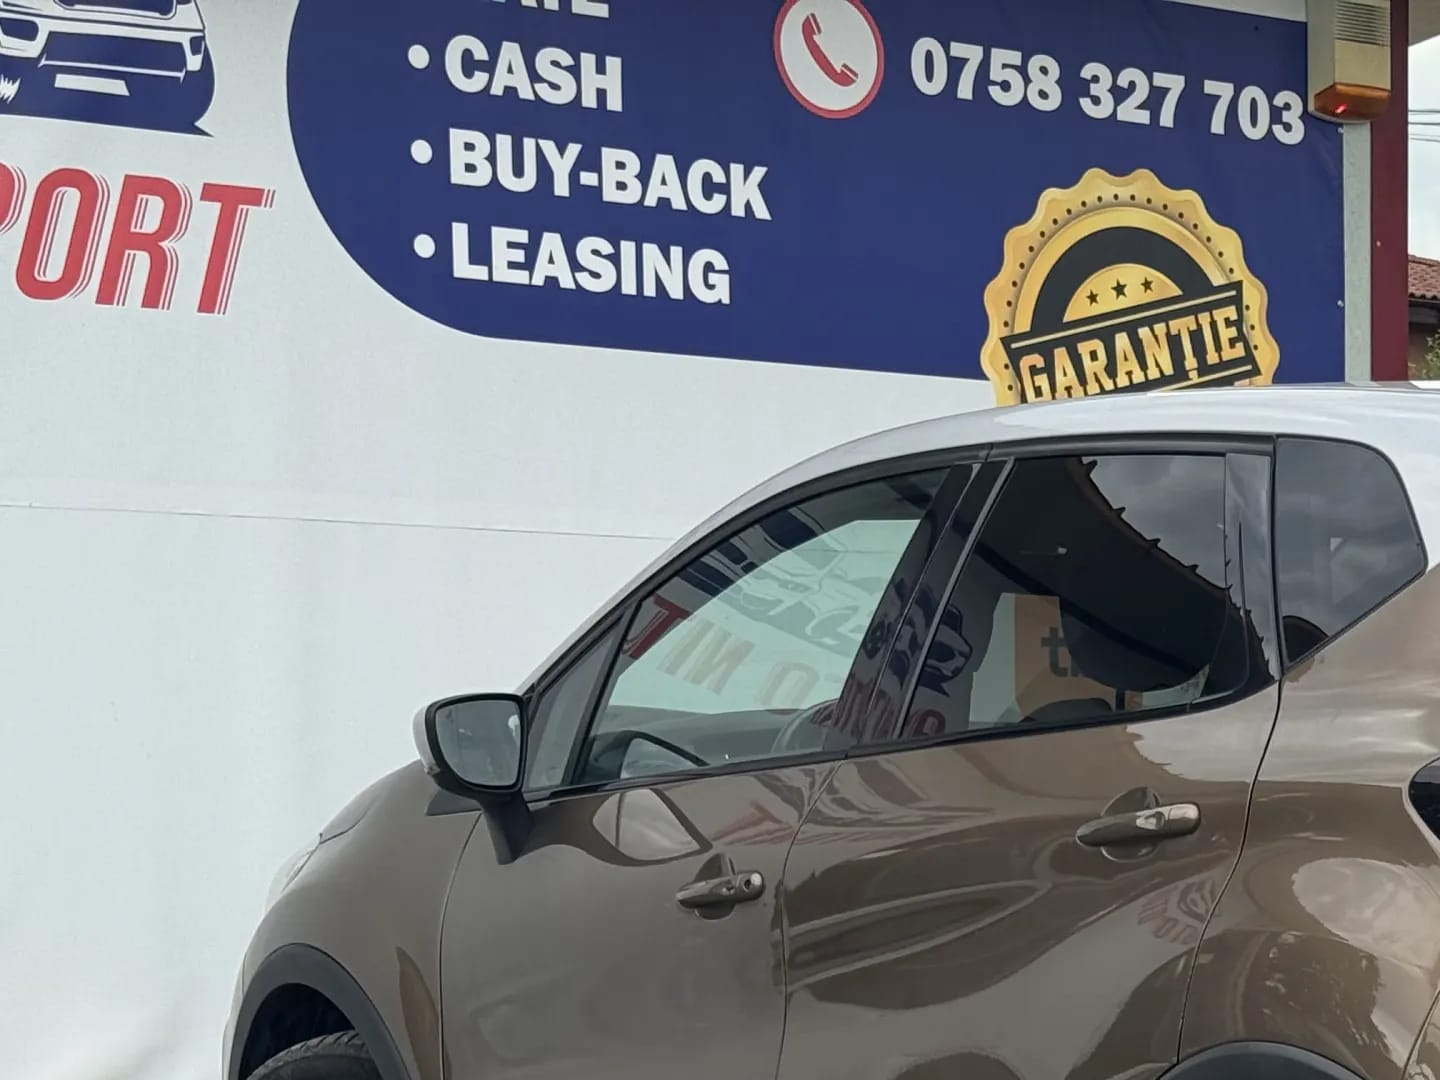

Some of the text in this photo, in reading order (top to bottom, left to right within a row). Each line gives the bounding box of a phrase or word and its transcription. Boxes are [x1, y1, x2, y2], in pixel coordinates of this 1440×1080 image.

[445, 34, 622, 112] CASH
[911, 37, 1305, 145] 0758 327 703
[449, 128, 772, 220] BUY-BACK
[451, 222, 731, 304] LEASING
